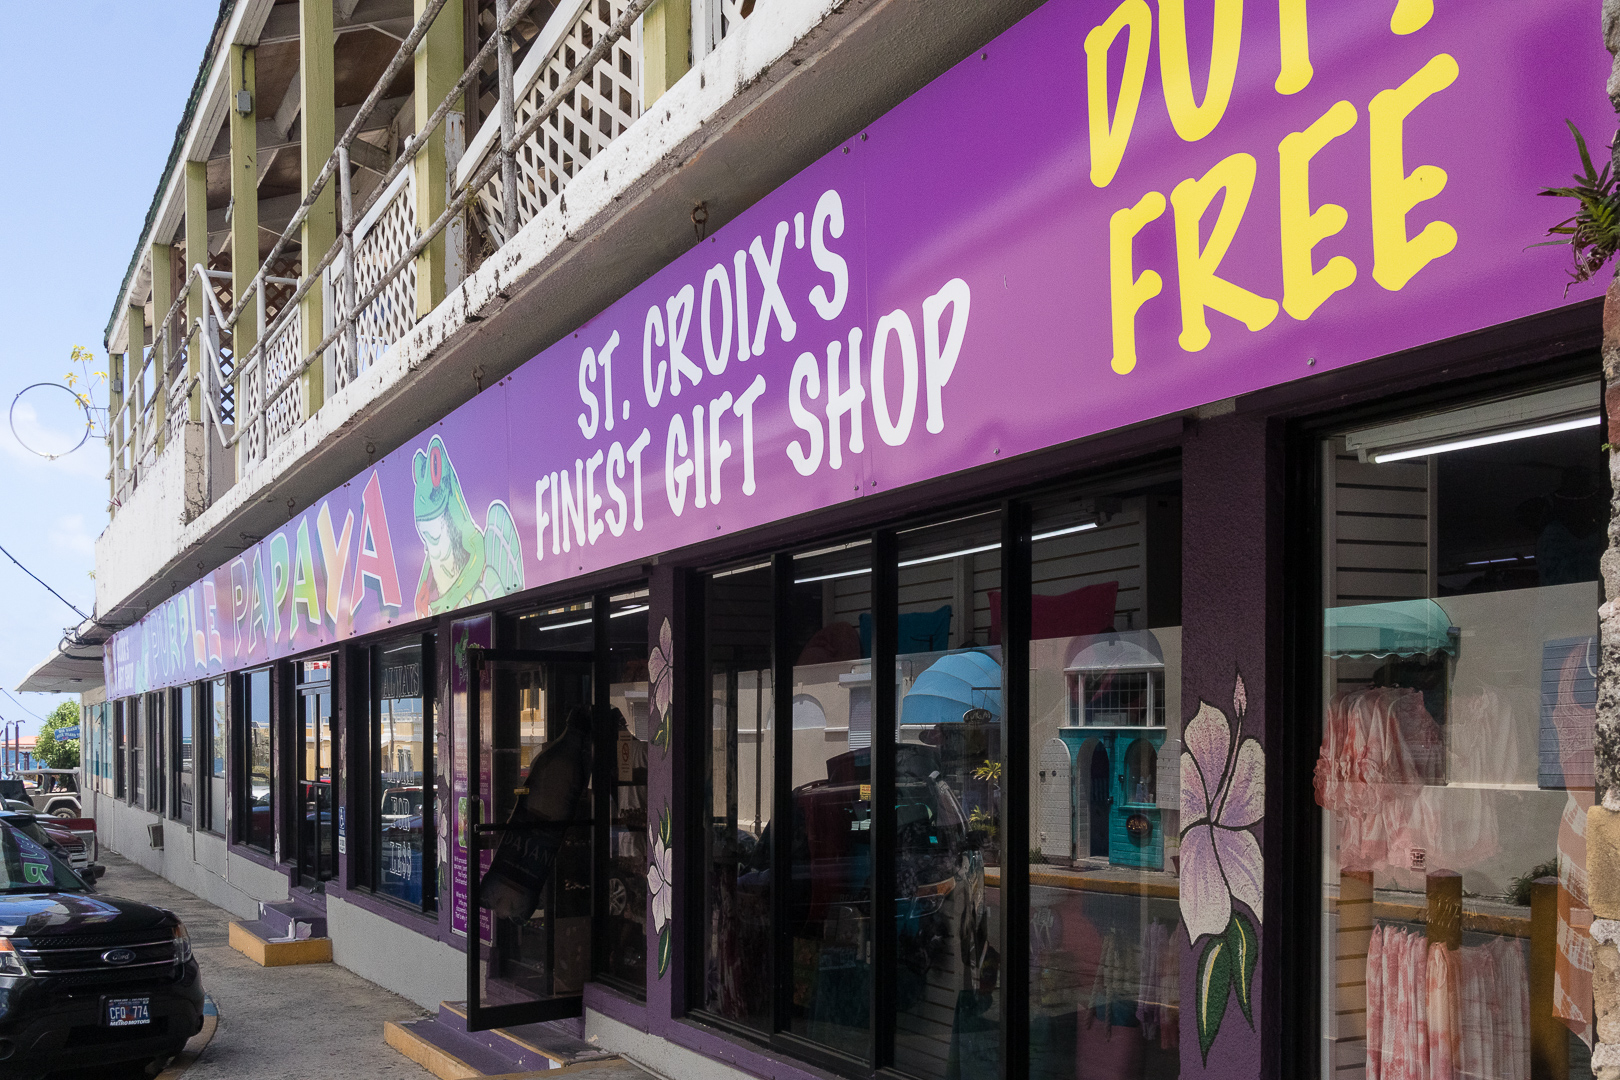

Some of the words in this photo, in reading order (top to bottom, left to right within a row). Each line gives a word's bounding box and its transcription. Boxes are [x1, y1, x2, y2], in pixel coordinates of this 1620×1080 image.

[1084, 0, 1434, 188] DU
[1110, 53, 1459, 375] FREE
[578, 330, 631, 440] ST.
[642, 189, 849, 408] CROIX'S
[535, 428, 651, 561] FINEST
[664, 374, 767, 517] GIFT
[786, 278, 971, 476] SHOP
[151, 581, 222, 680] PURPLE
[231, 469, 402, 657] PAPAYA
[382, 662, 420, 699] ALWAYS
[390, 795, 411, 832] FOR
[109, 1006, 126, 1020] CFQ
[132, 1005, 149, 1018] 774
